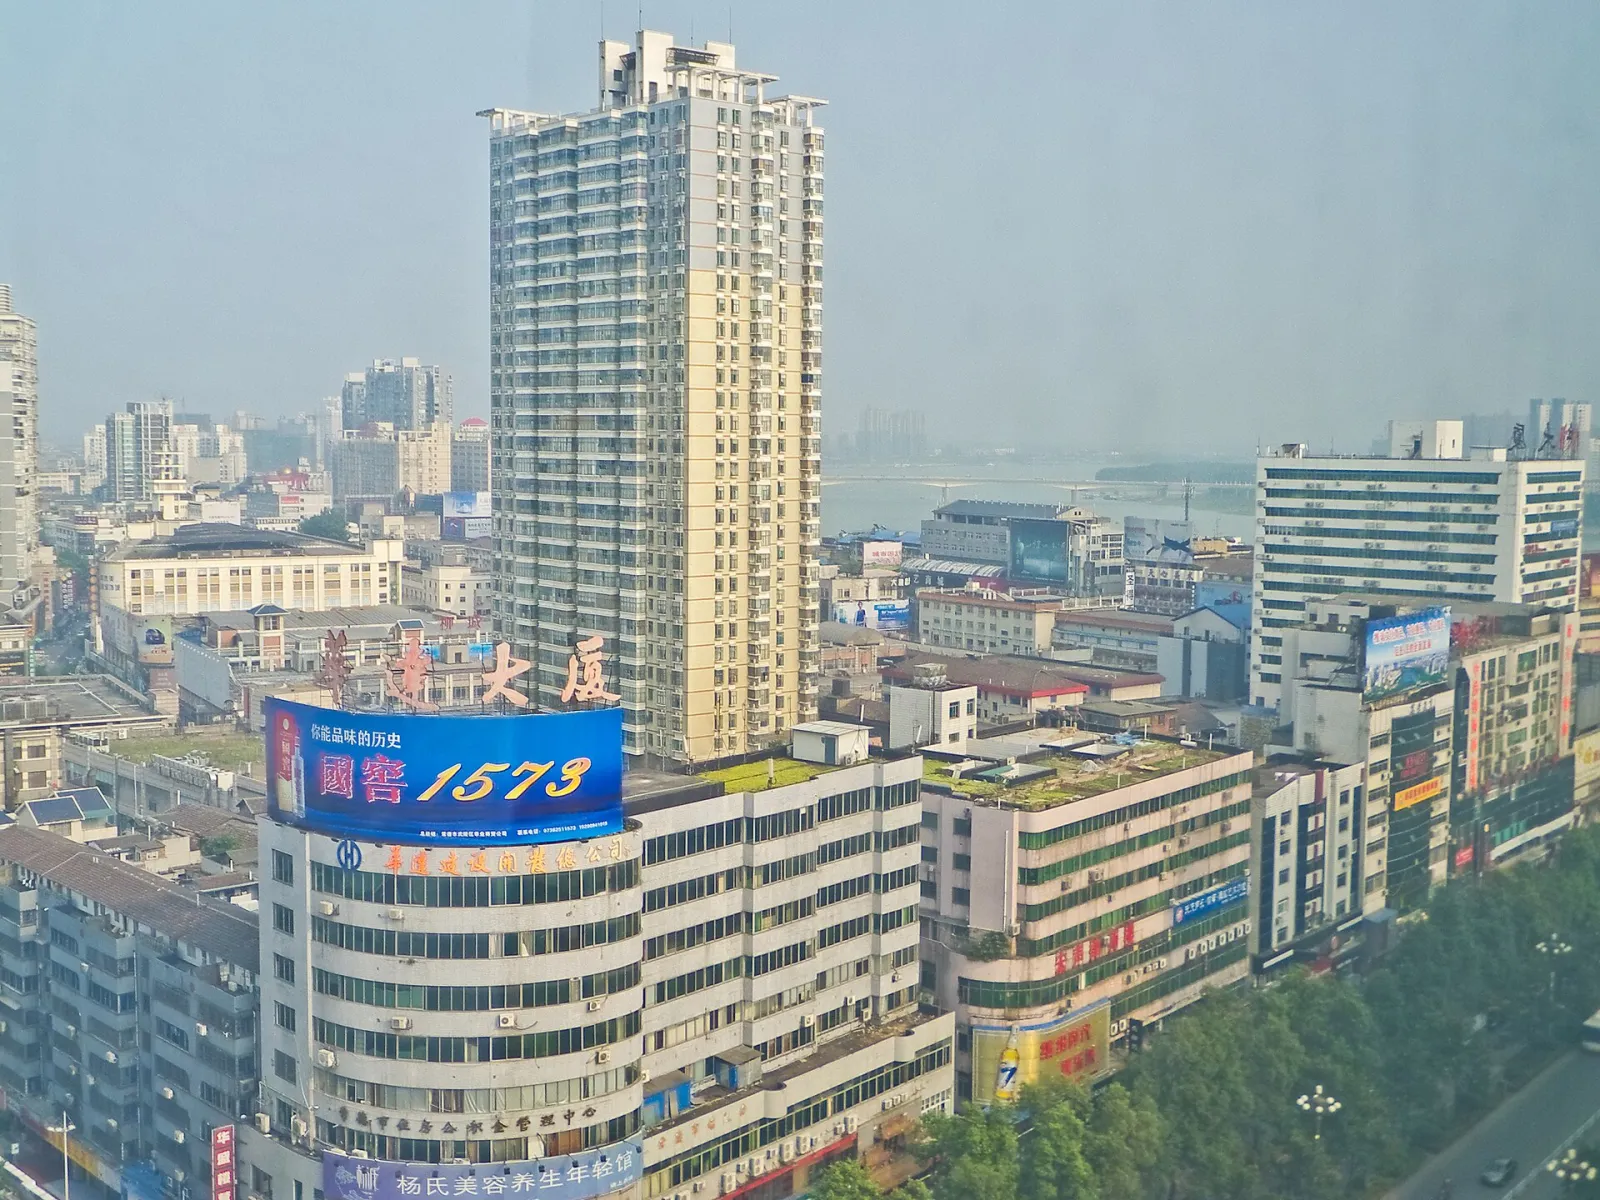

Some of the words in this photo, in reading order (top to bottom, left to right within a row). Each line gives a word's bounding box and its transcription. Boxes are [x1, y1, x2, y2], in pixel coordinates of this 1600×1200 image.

[310, 724, 402, 748] 你能品味的历史
[417, 757, 592, 801] 1573
[397, 1150, 634, 1197] 杨氏美容养生年轻馆
